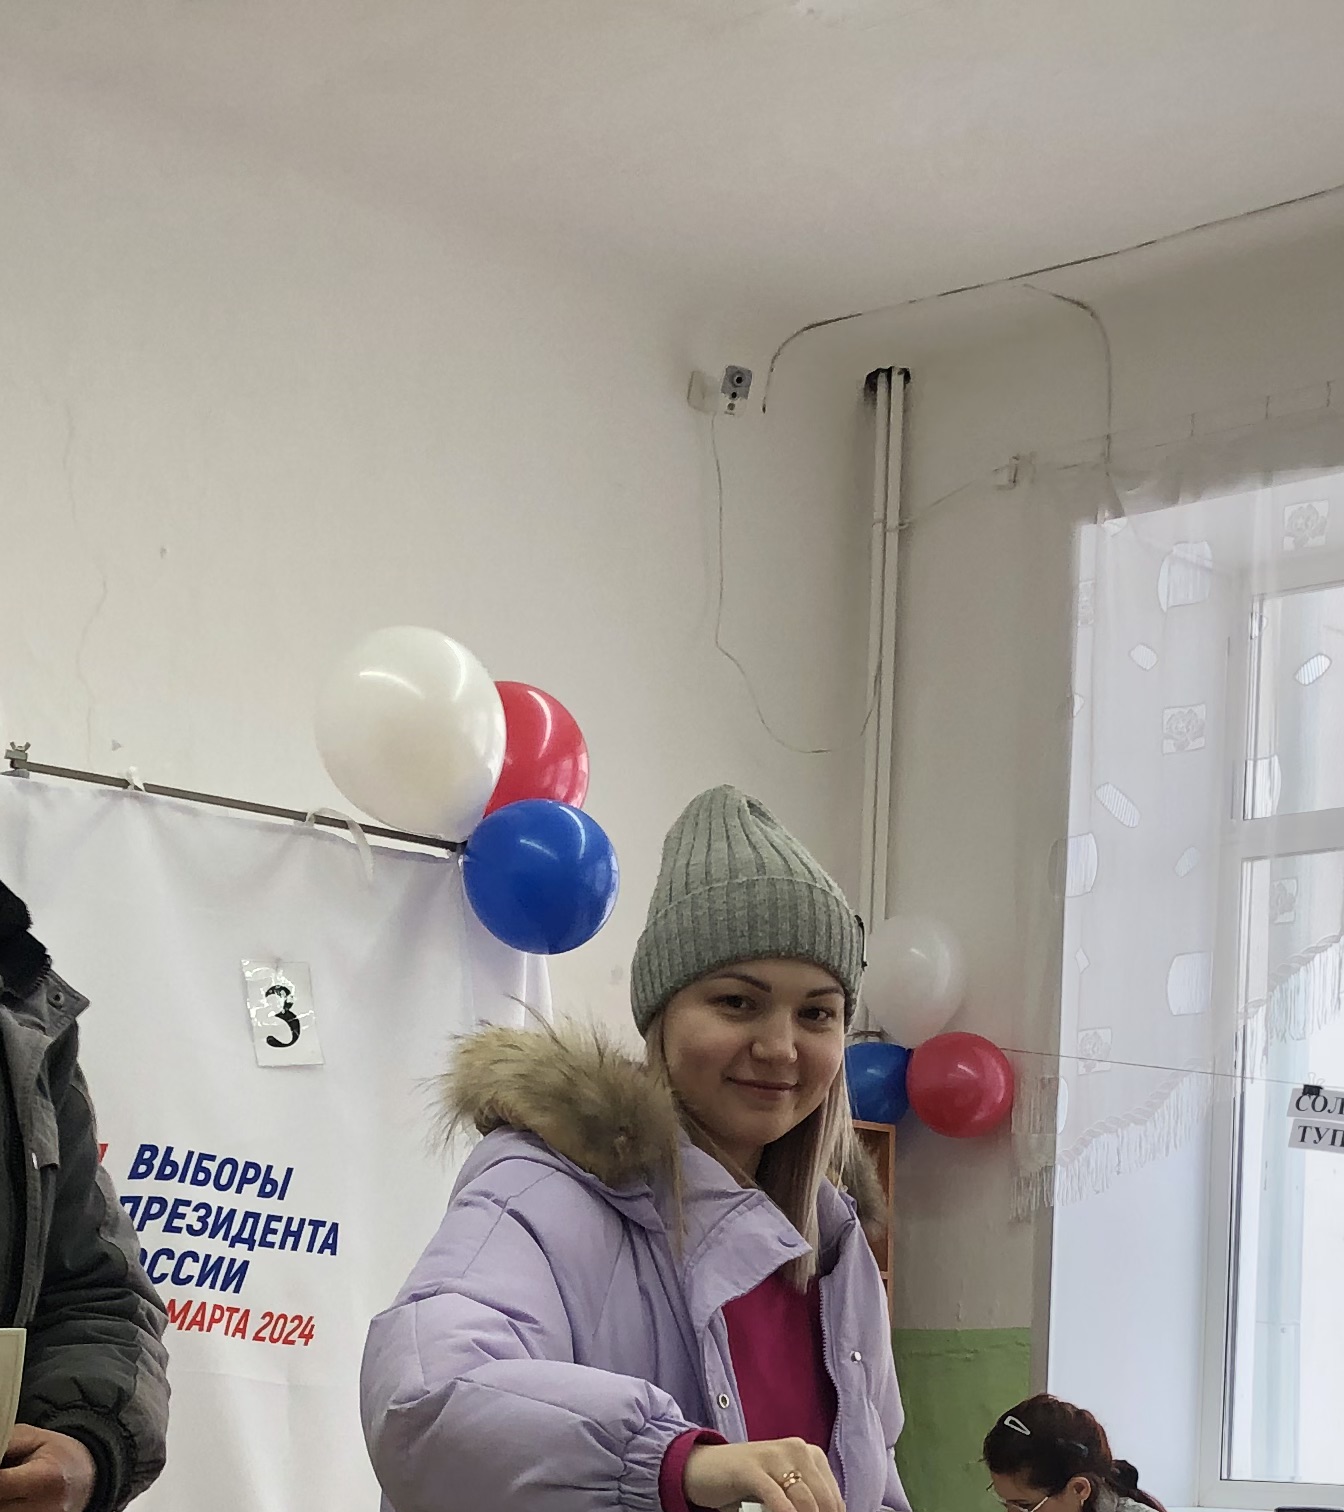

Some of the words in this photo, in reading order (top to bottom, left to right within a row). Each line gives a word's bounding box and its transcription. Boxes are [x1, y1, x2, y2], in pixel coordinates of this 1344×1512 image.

[265, 984, 301, 1048] 3
[127, 1143, 295, 1201] ВЫБОРЫ
[166, 1298, 251, 1340] МАРТА
[252, 1311, 316, 1347] 2024
